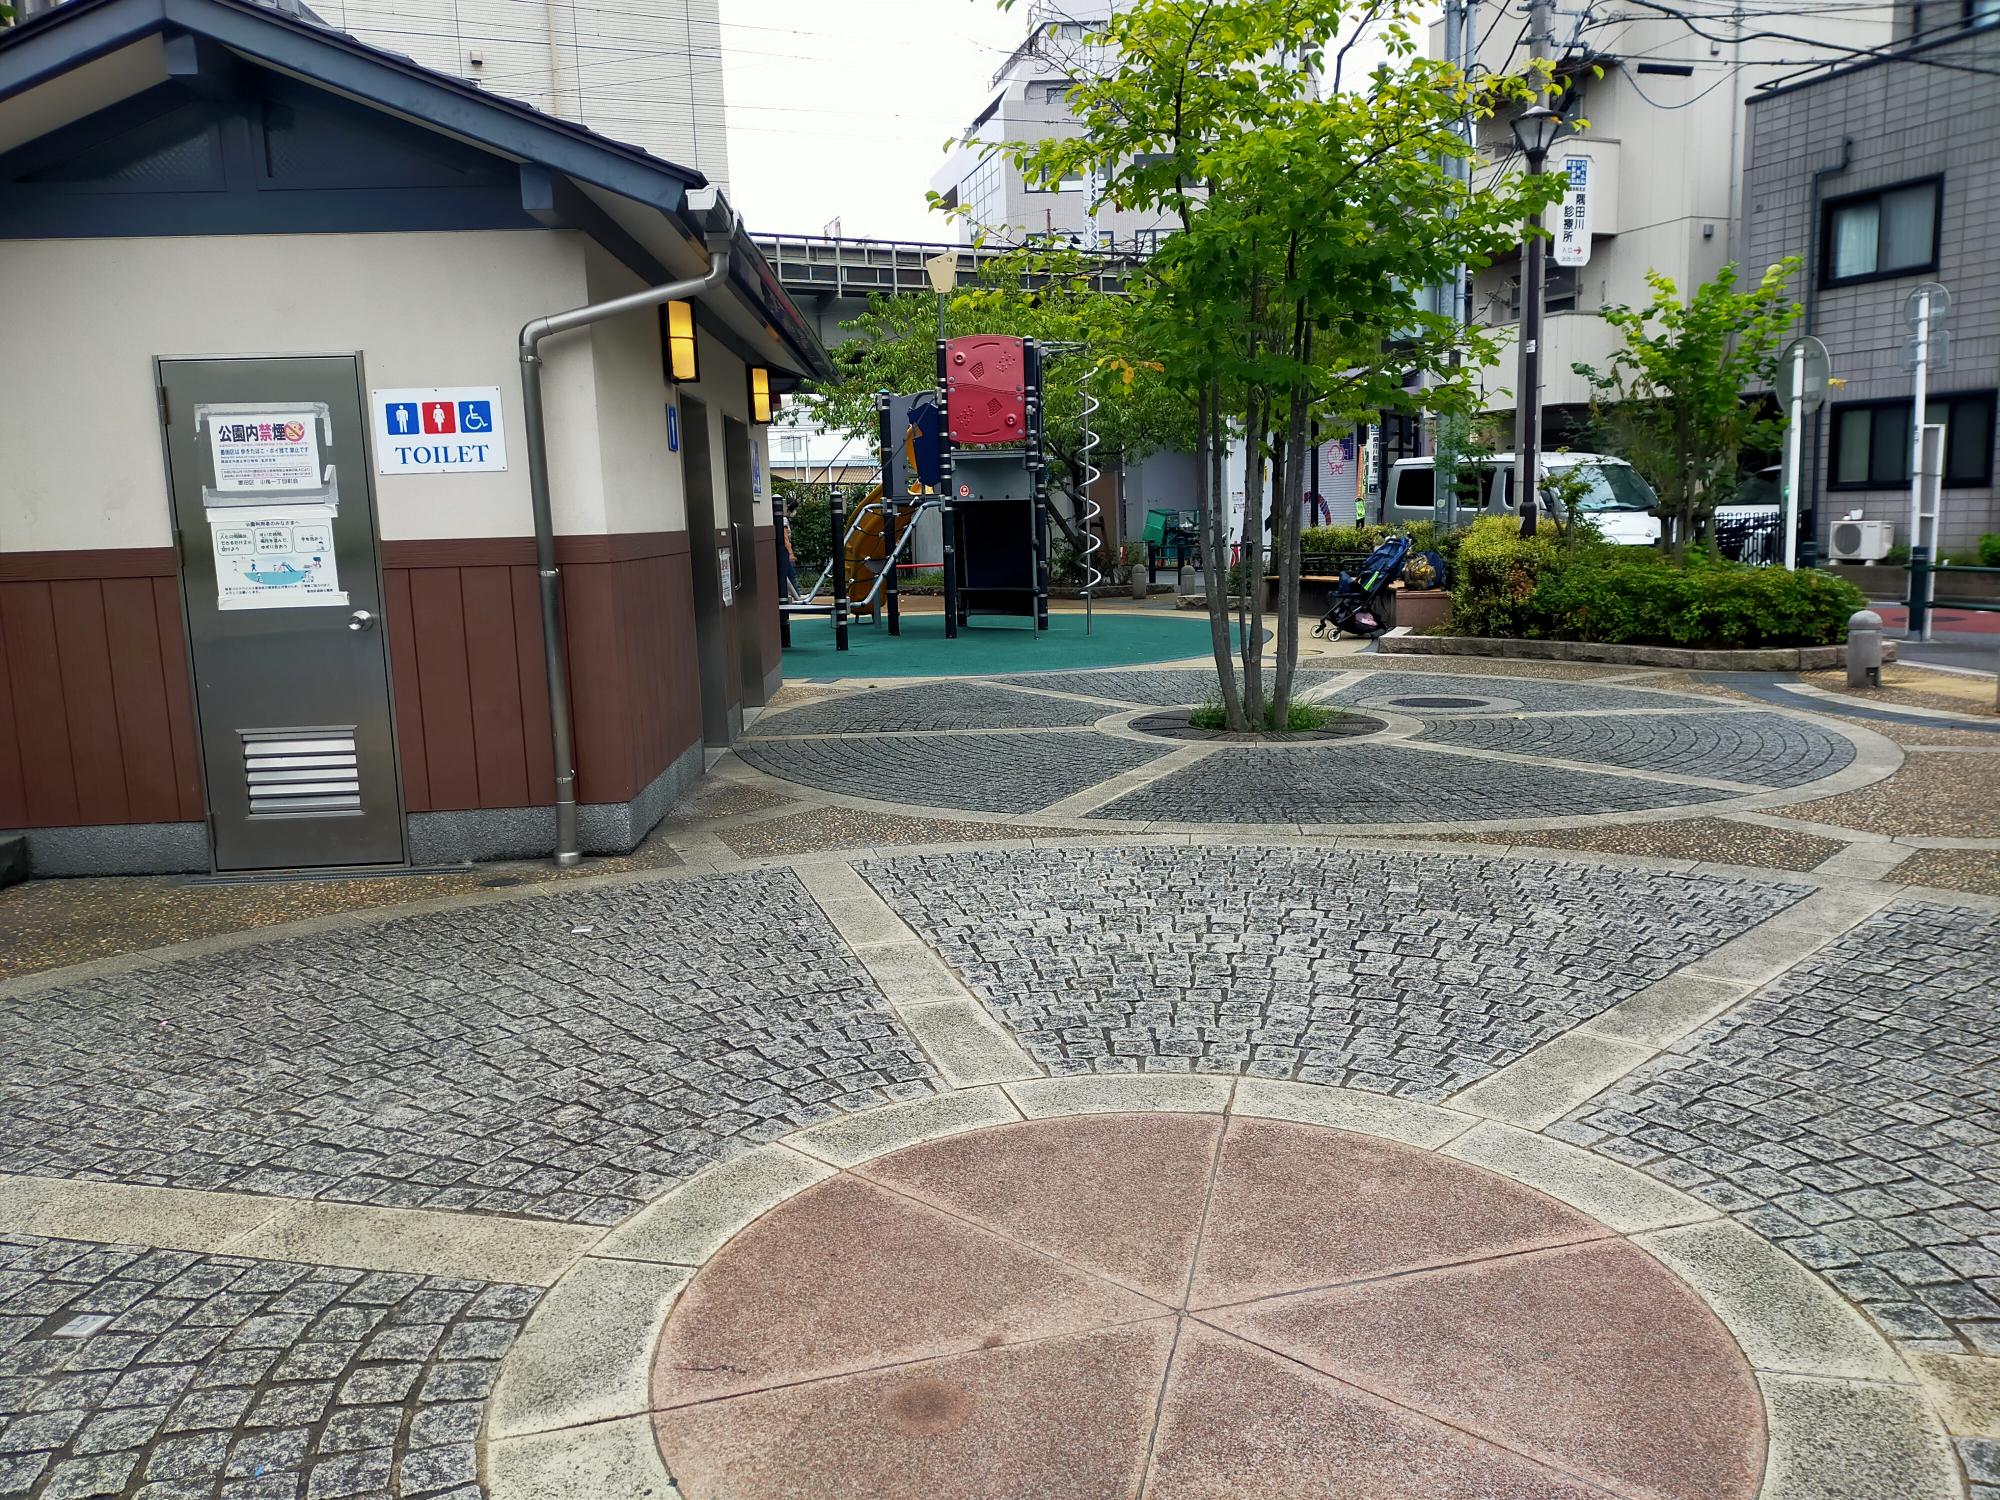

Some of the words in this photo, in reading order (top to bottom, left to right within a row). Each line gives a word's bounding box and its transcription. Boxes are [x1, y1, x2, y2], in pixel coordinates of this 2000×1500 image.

[1563, 205, 1574, 243] 診療所
[1575, 193, 1586, 230] 隅田川
[219, 423, 286, 442] 公園内禁煙
[395, 444, 489, 465] TOILET
